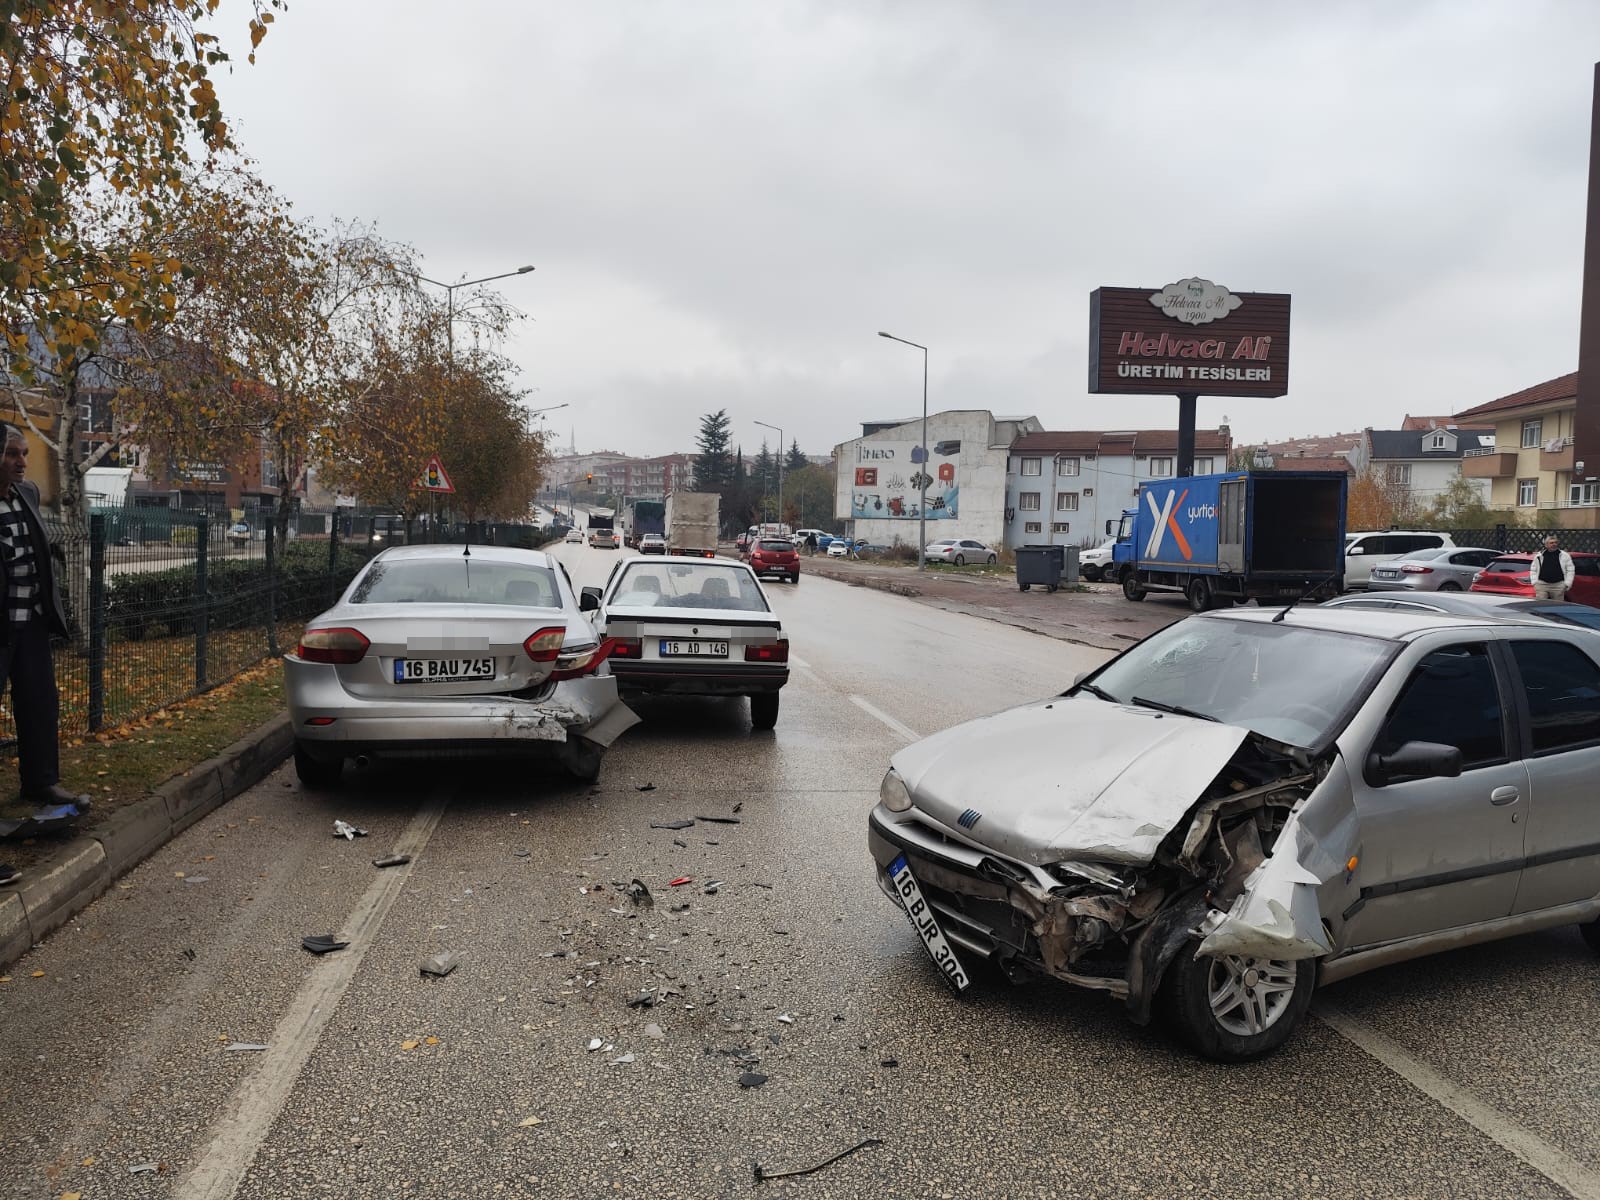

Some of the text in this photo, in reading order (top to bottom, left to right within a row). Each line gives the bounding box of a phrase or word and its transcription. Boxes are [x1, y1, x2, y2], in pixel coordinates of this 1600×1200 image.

[1185, 311, 1207, 321] 1900
[1117, 331, 1272, 361] Helvacı Ali
[1117, 361, 1271, 382] ÜRETİM TESİSLERİ
[668, 642, 680, 654] 16
[687, 642, 701, 654] AD
[708, 643, 727, 655] 146
[406, 661, 424, 678] 16
[428, 660, 460, 677] BAU
[462, 659, 492, 676] 745
[896, 870, 916, 899] 16
[909, 897, 939, 943] BJR
